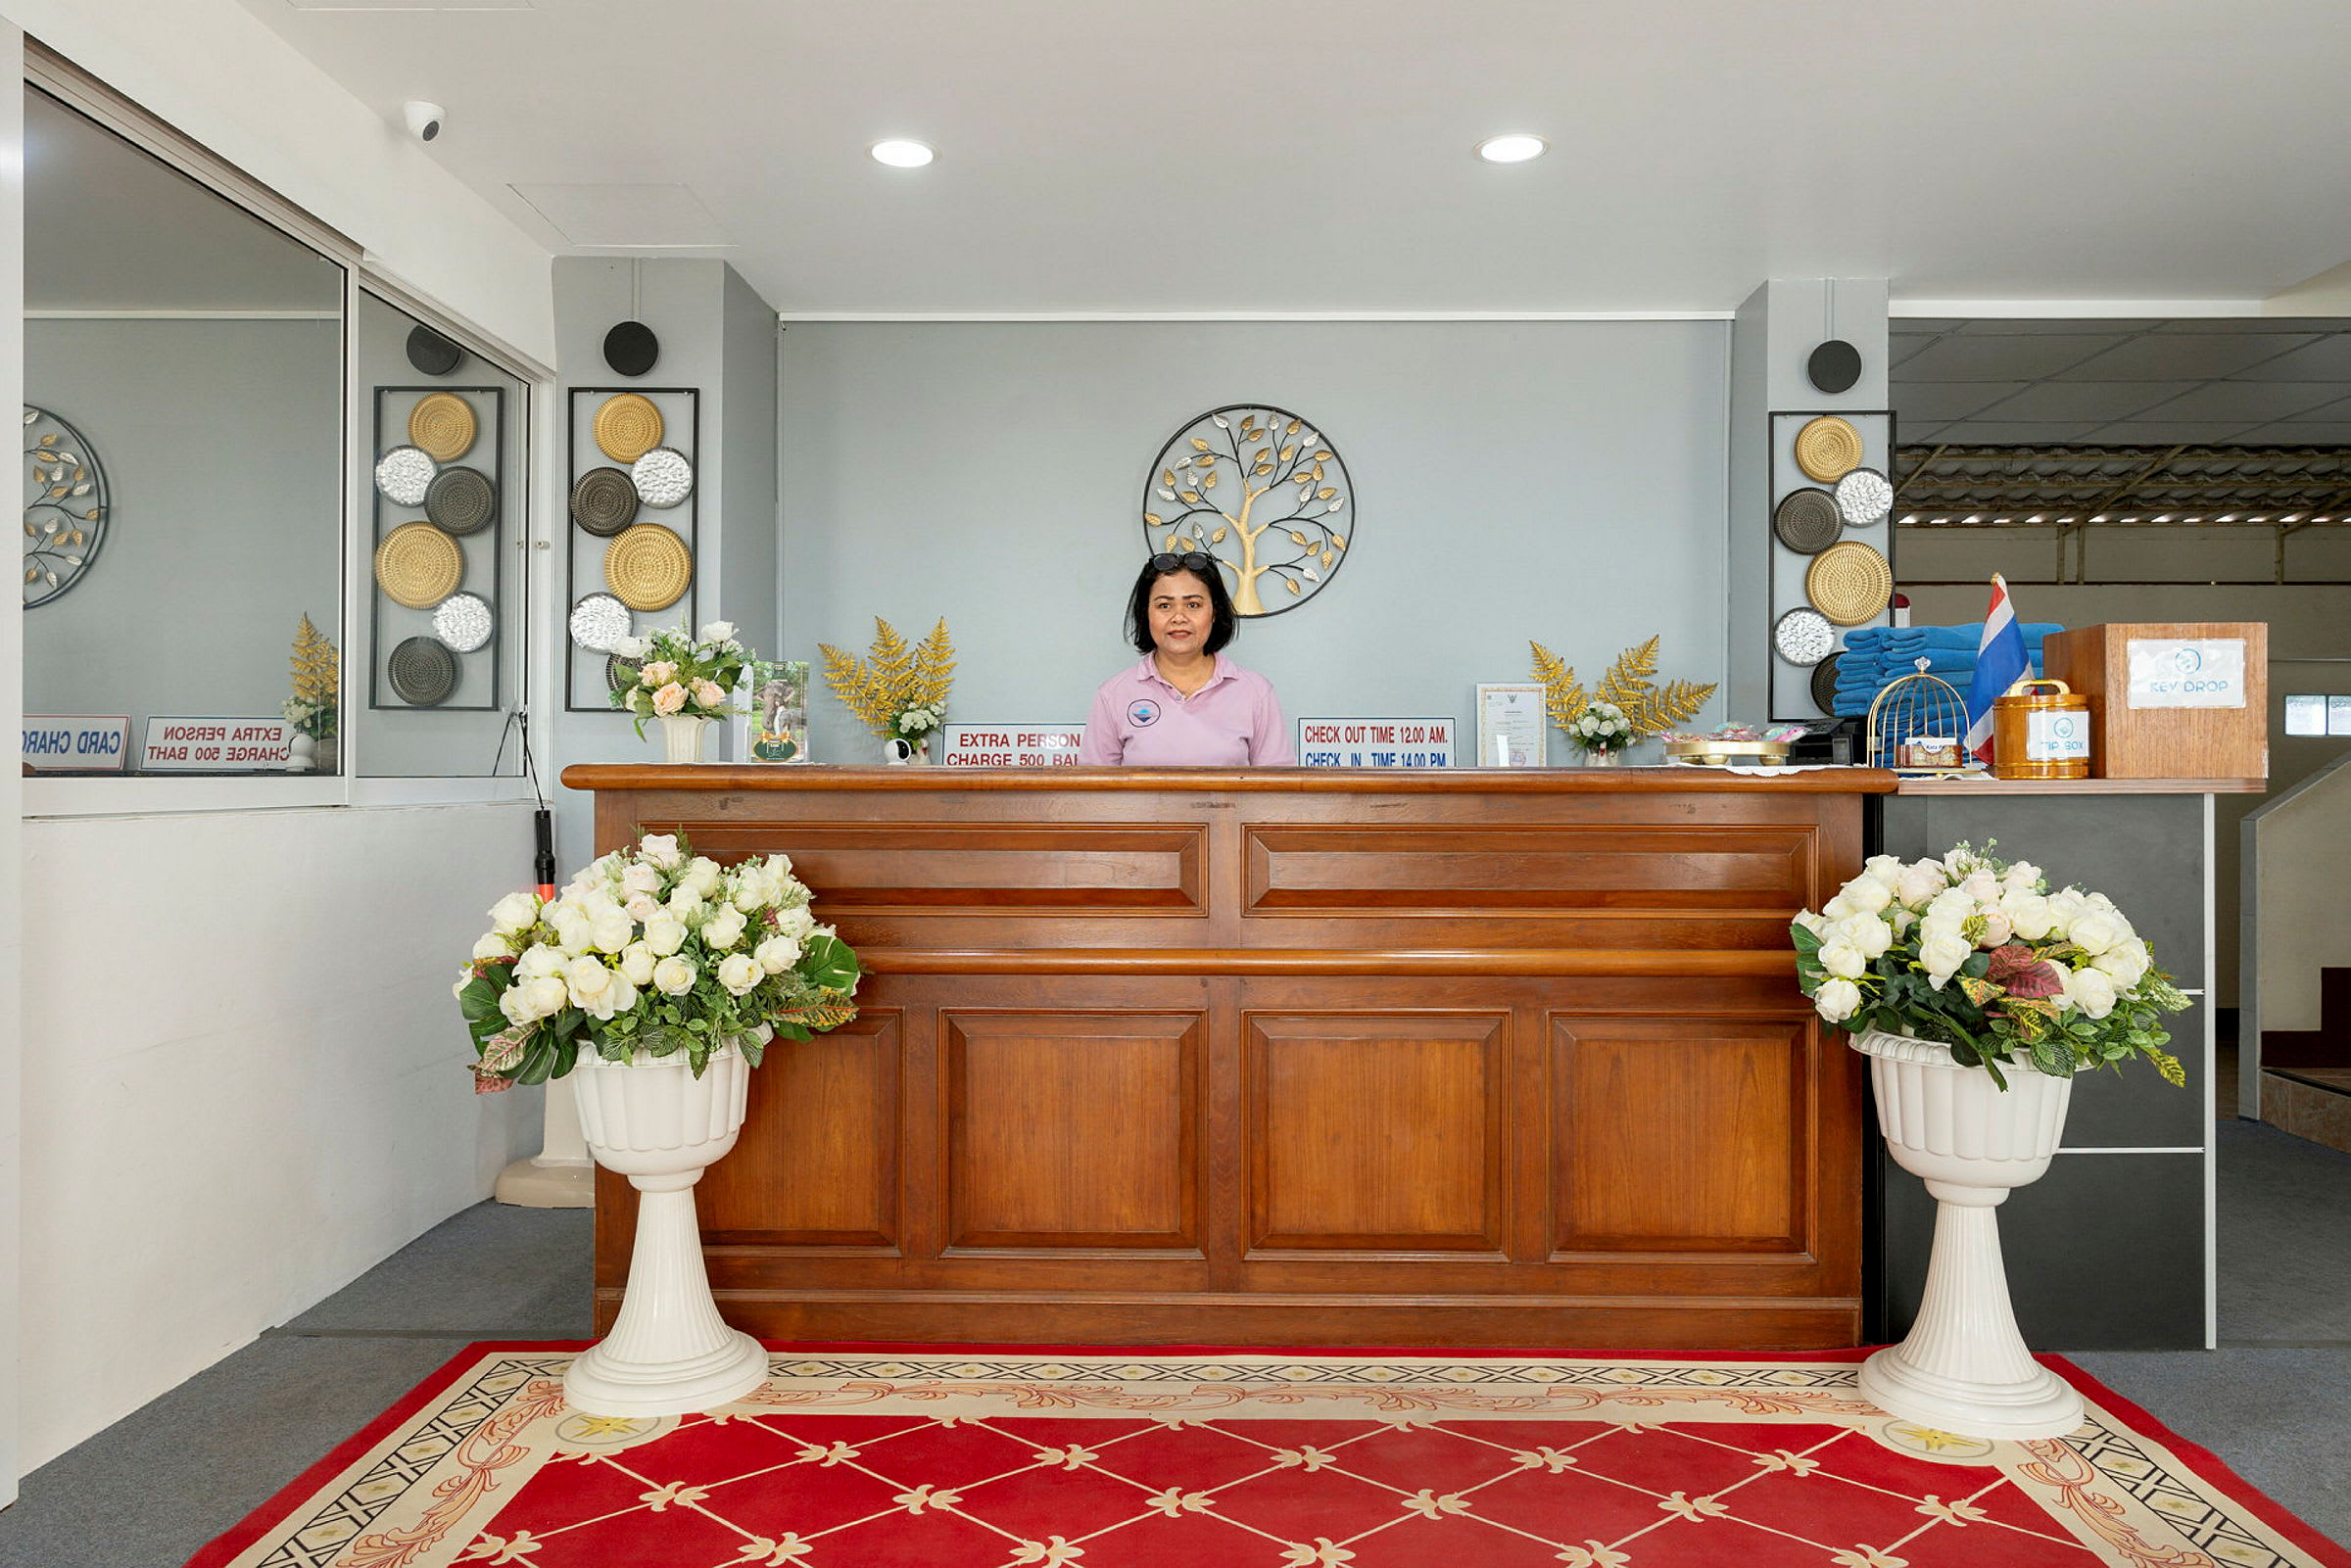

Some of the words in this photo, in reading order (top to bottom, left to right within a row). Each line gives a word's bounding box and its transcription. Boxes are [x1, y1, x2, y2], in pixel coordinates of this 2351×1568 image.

[2183, 680, 2229, 692] DROP
[959, 733, 1011, 747] EXTRA
[1017, 733, 1080, 747] PERSON
[1305, 726, 1341, 743] CHECK
[1345, 726, 1366, 743] OUT
[1370, 726, 1395, 743] TIME
[1400, 726, 1424, 743] 12.00
[1428, 726, 1448, 743] AM.
[946, 753, 1012, 767] CHARGE
[1019, 753, 1045, 767] 500
[1305, 752, 1341, 767] CHECK
[1351, 752, 1362, 767] IN
[1371, 752, 1396, 767] TIME
